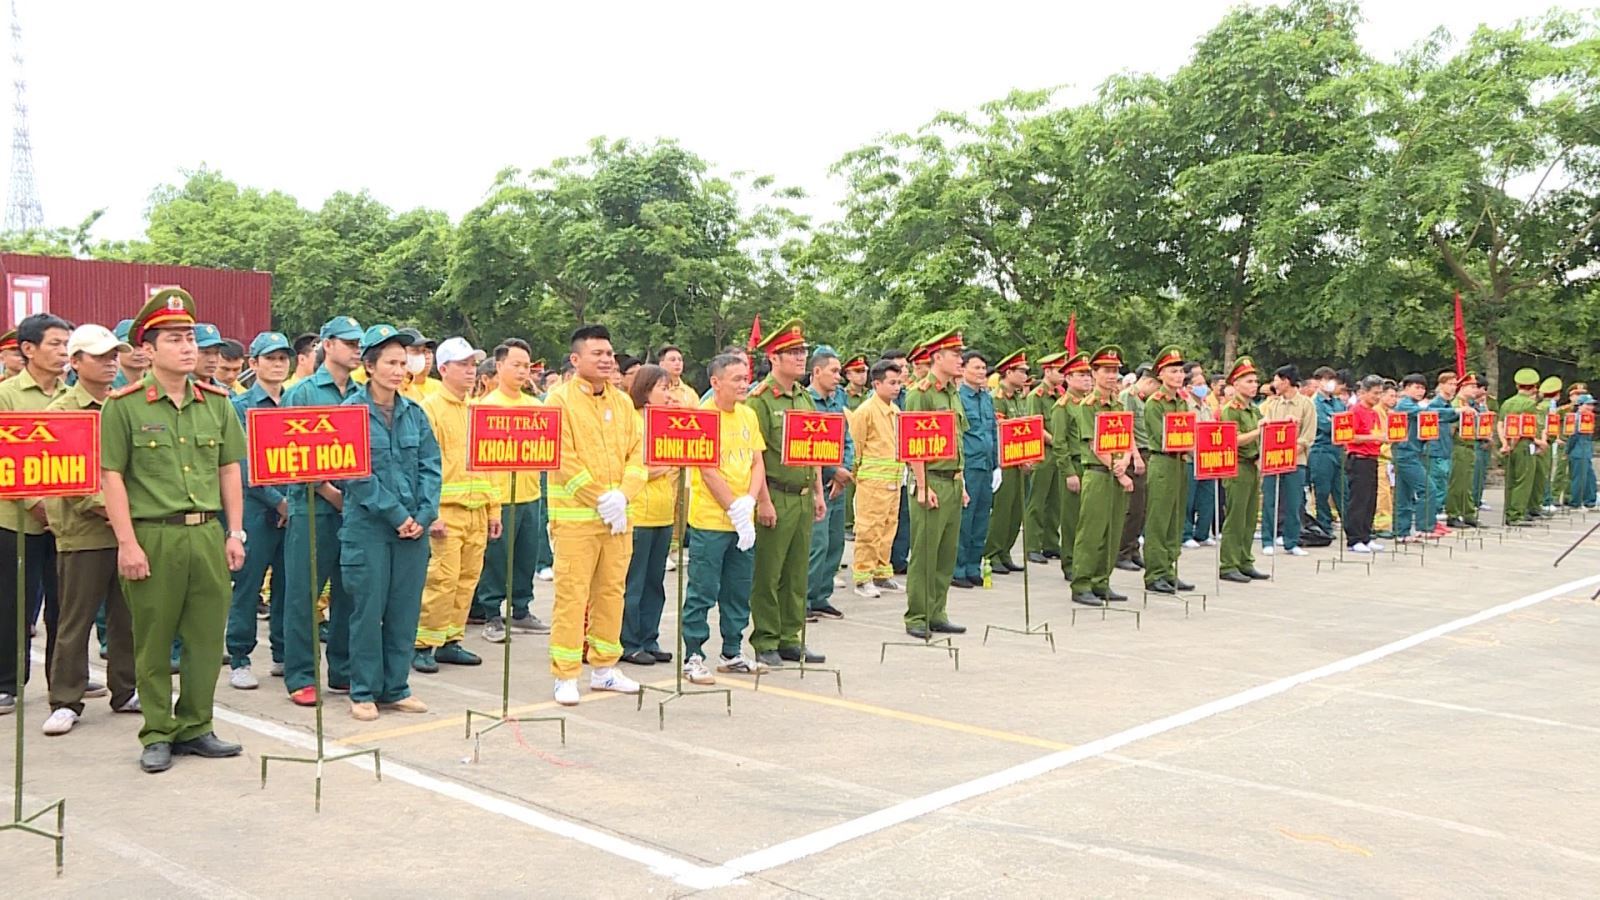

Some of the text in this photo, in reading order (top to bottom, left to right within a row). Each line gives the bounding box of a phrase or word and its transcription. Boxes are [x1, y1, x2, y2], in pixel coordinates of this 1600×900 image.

[0, 420, 60, 443] XÃ
[283, 414, 339, 436] XÃ
[486, 411, 549, 433] THỊ TRẤN
[668, 414, 702, 430] XÃ
[802, 419, 829, 433] XÃ
[914, 416, 941, 431] XÃ
[1012, 422, 1032, 437] XÃ
[478, 435, 555, 463] KHOÁI CHÂU
[655, 433, 684, 459] BÌNH
[908, 433, 947, 460] ĐẠI TẬP
[23, 450, 86, 486] ĐÌNH
[265, 438, 357, 479] VIỆT HÒA
